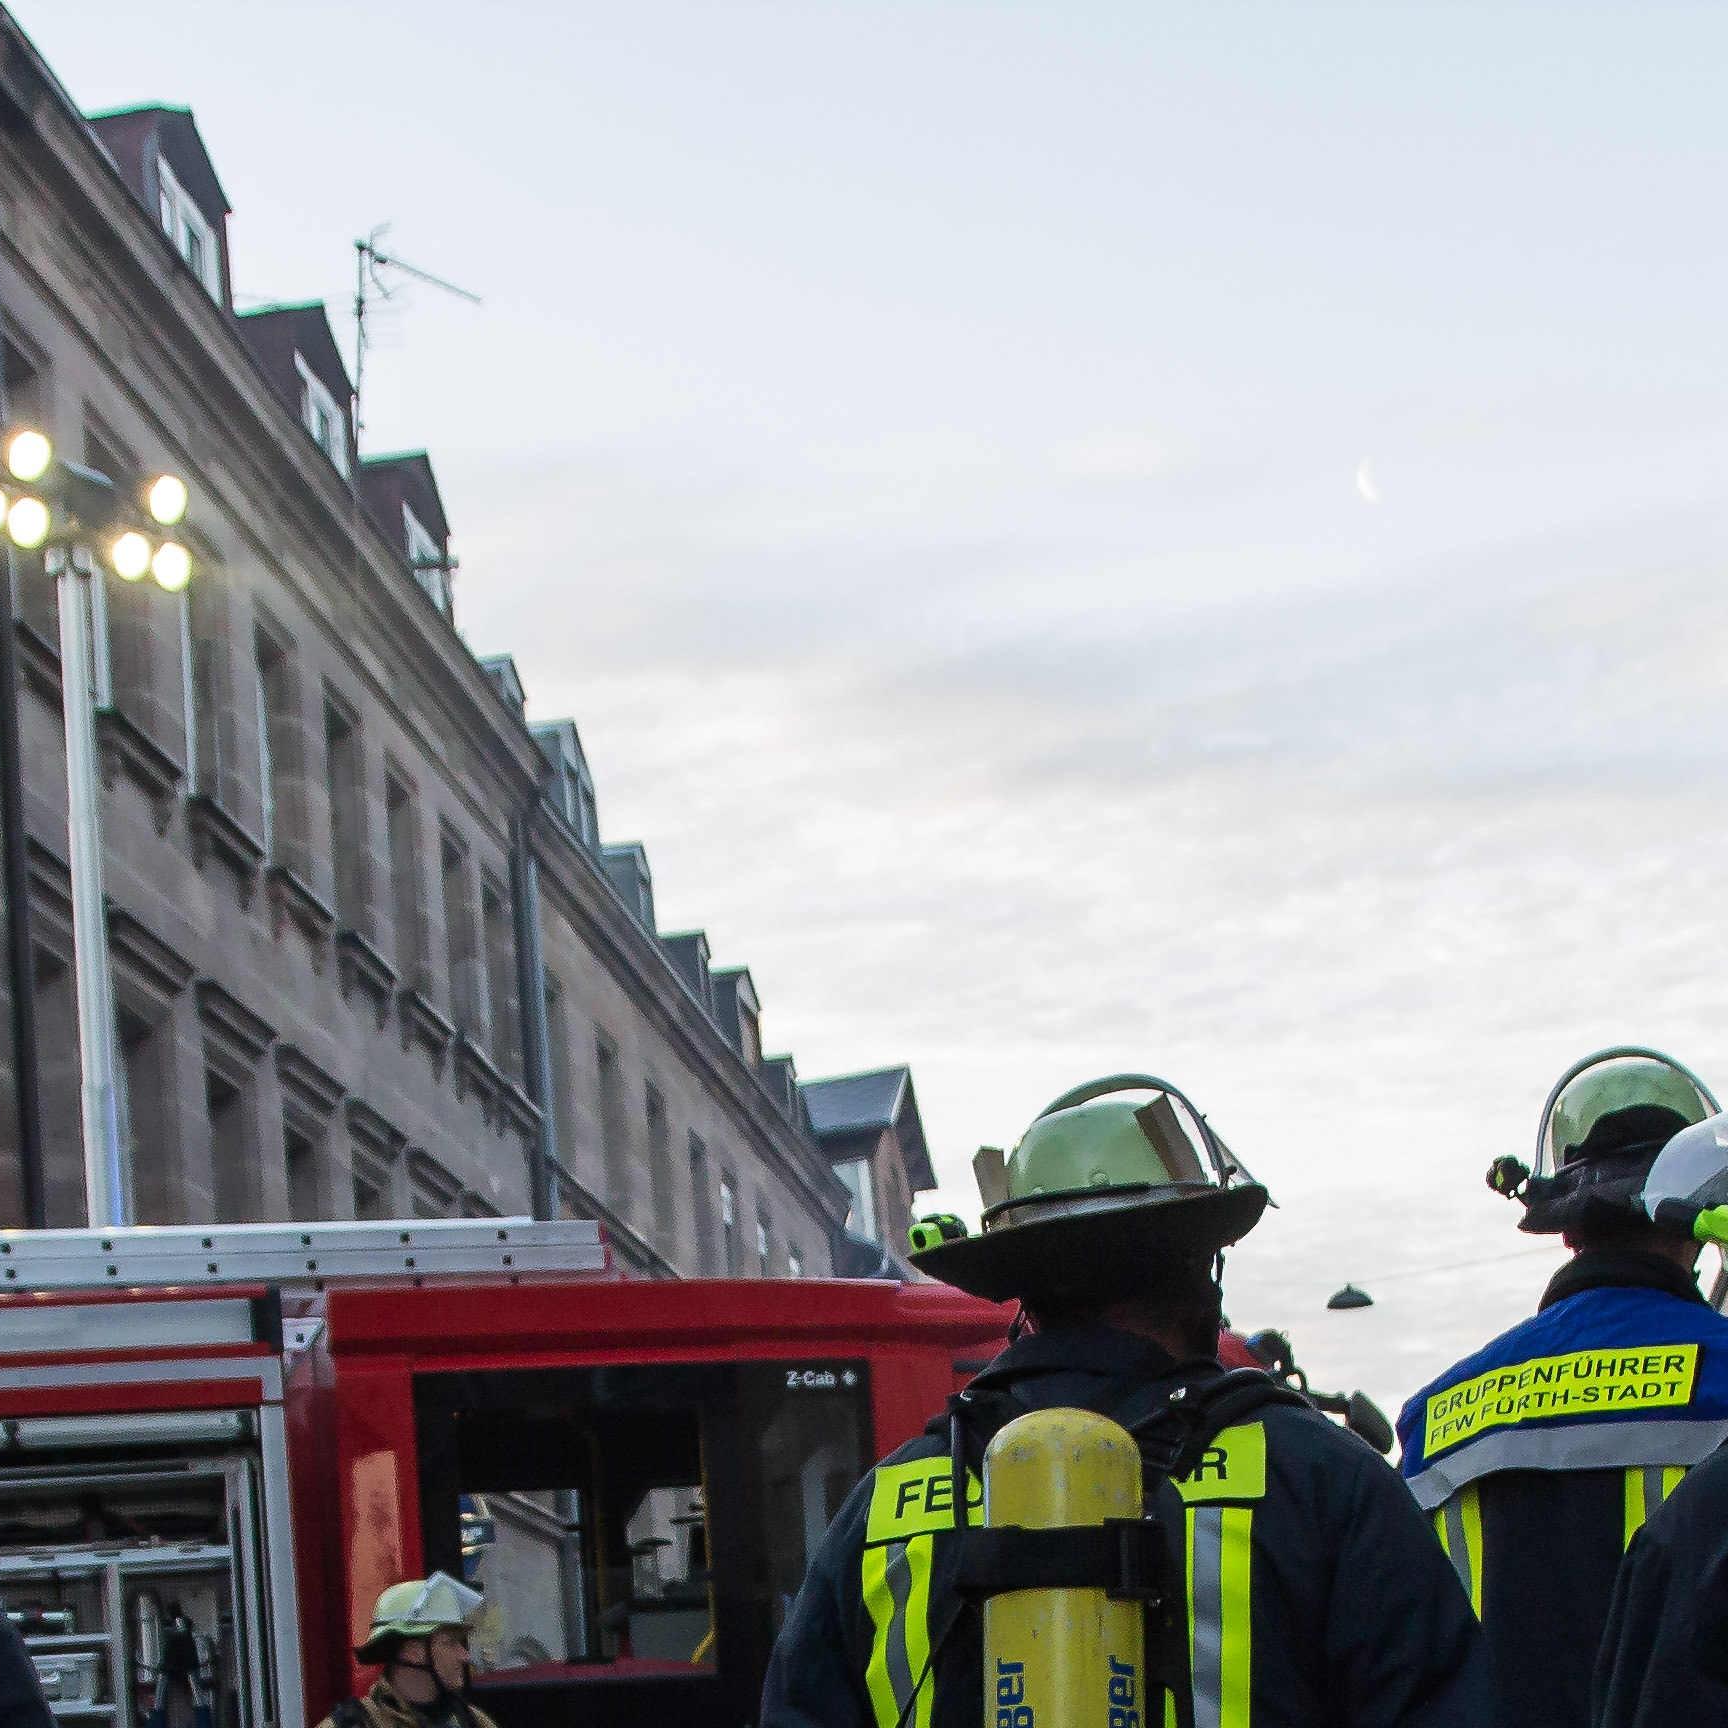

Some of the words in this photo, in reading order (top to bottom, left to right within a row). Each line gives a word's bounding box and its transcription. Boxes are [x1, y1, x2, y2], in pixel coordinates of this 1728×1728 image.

[1429, 1411, 1476, 1446] FFW
[1480, 1381, 1683, 1421] FÜRTH-STADT
[1432, 1354, 1685, 1421] GRUPPENFÜHRER
